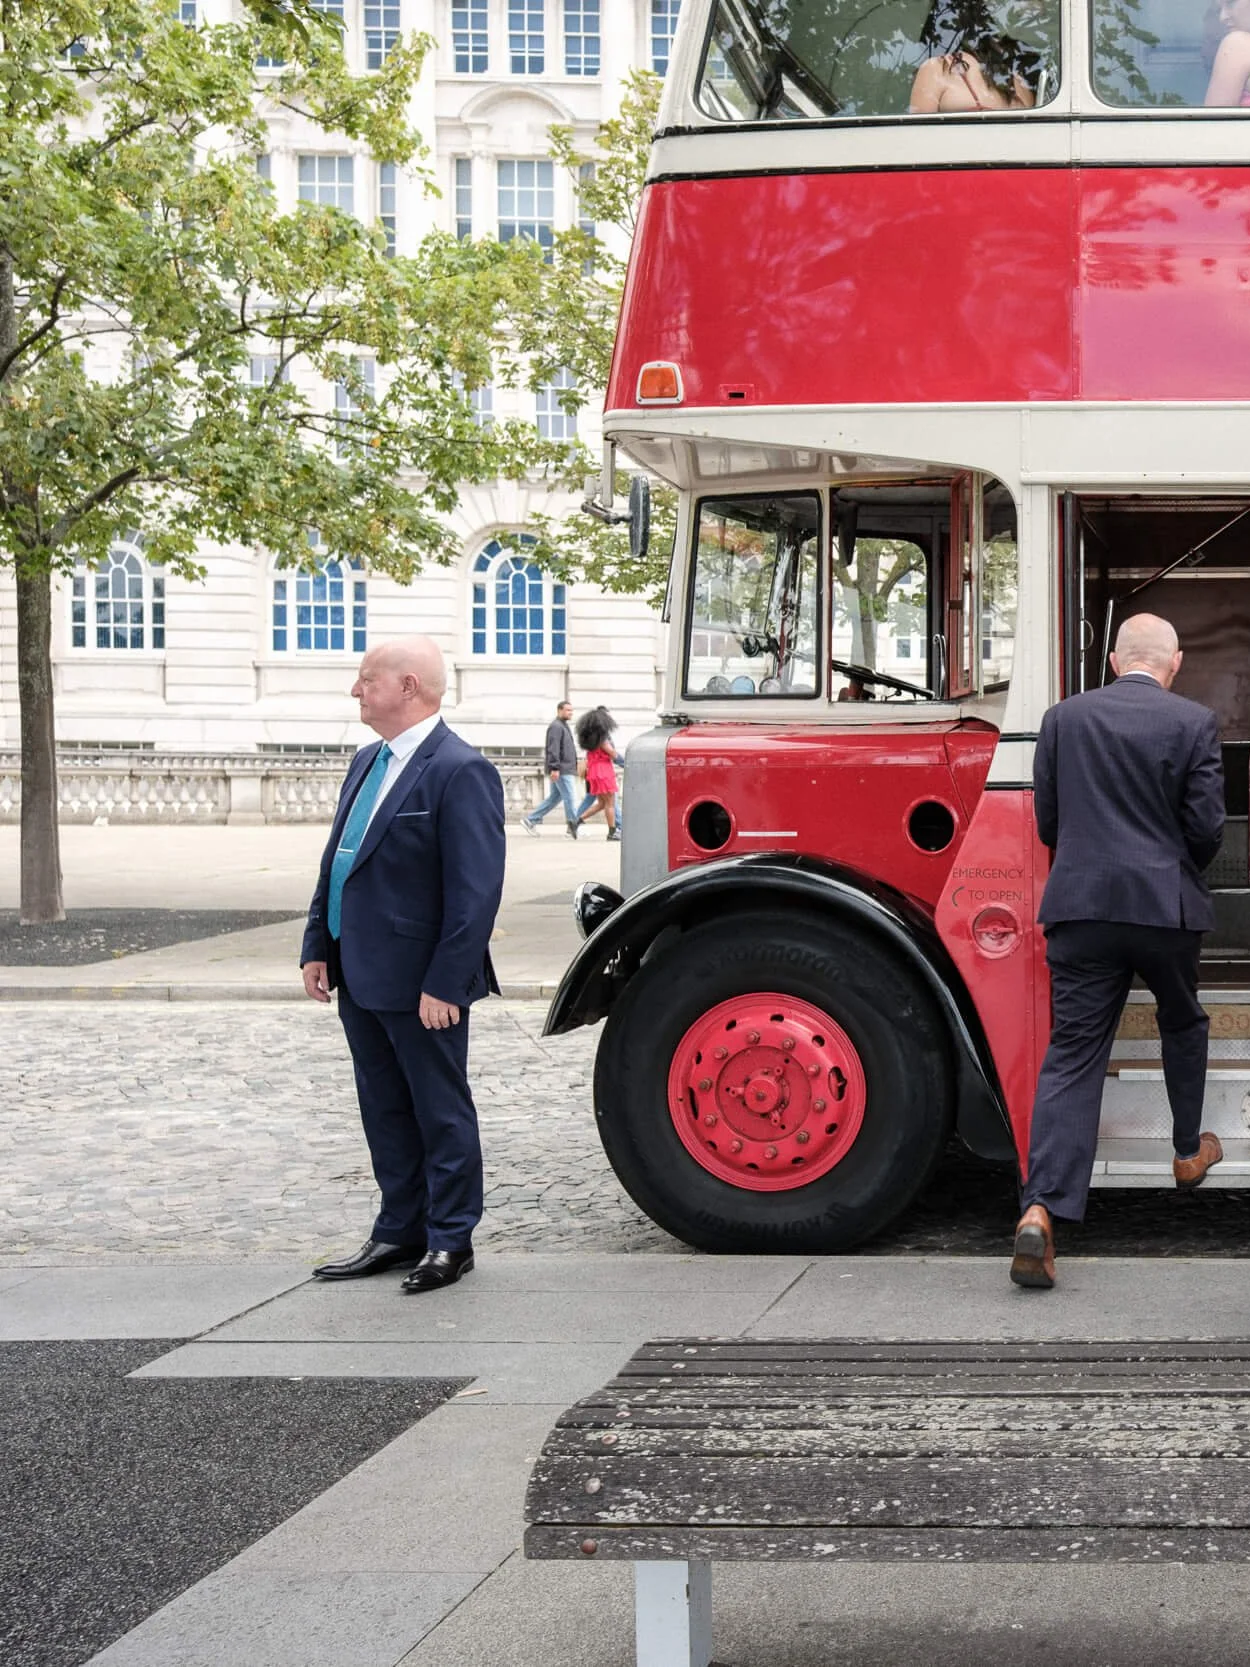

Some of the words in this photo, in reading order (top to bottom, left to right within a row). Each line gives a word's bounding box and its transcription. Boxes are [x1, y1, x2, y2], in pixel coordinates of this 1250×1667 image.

[952, 867, 1024, 879] EMERGENCY
[968, 889, 984, 900] TO
[989, 889, 1022, 900] OPEN
